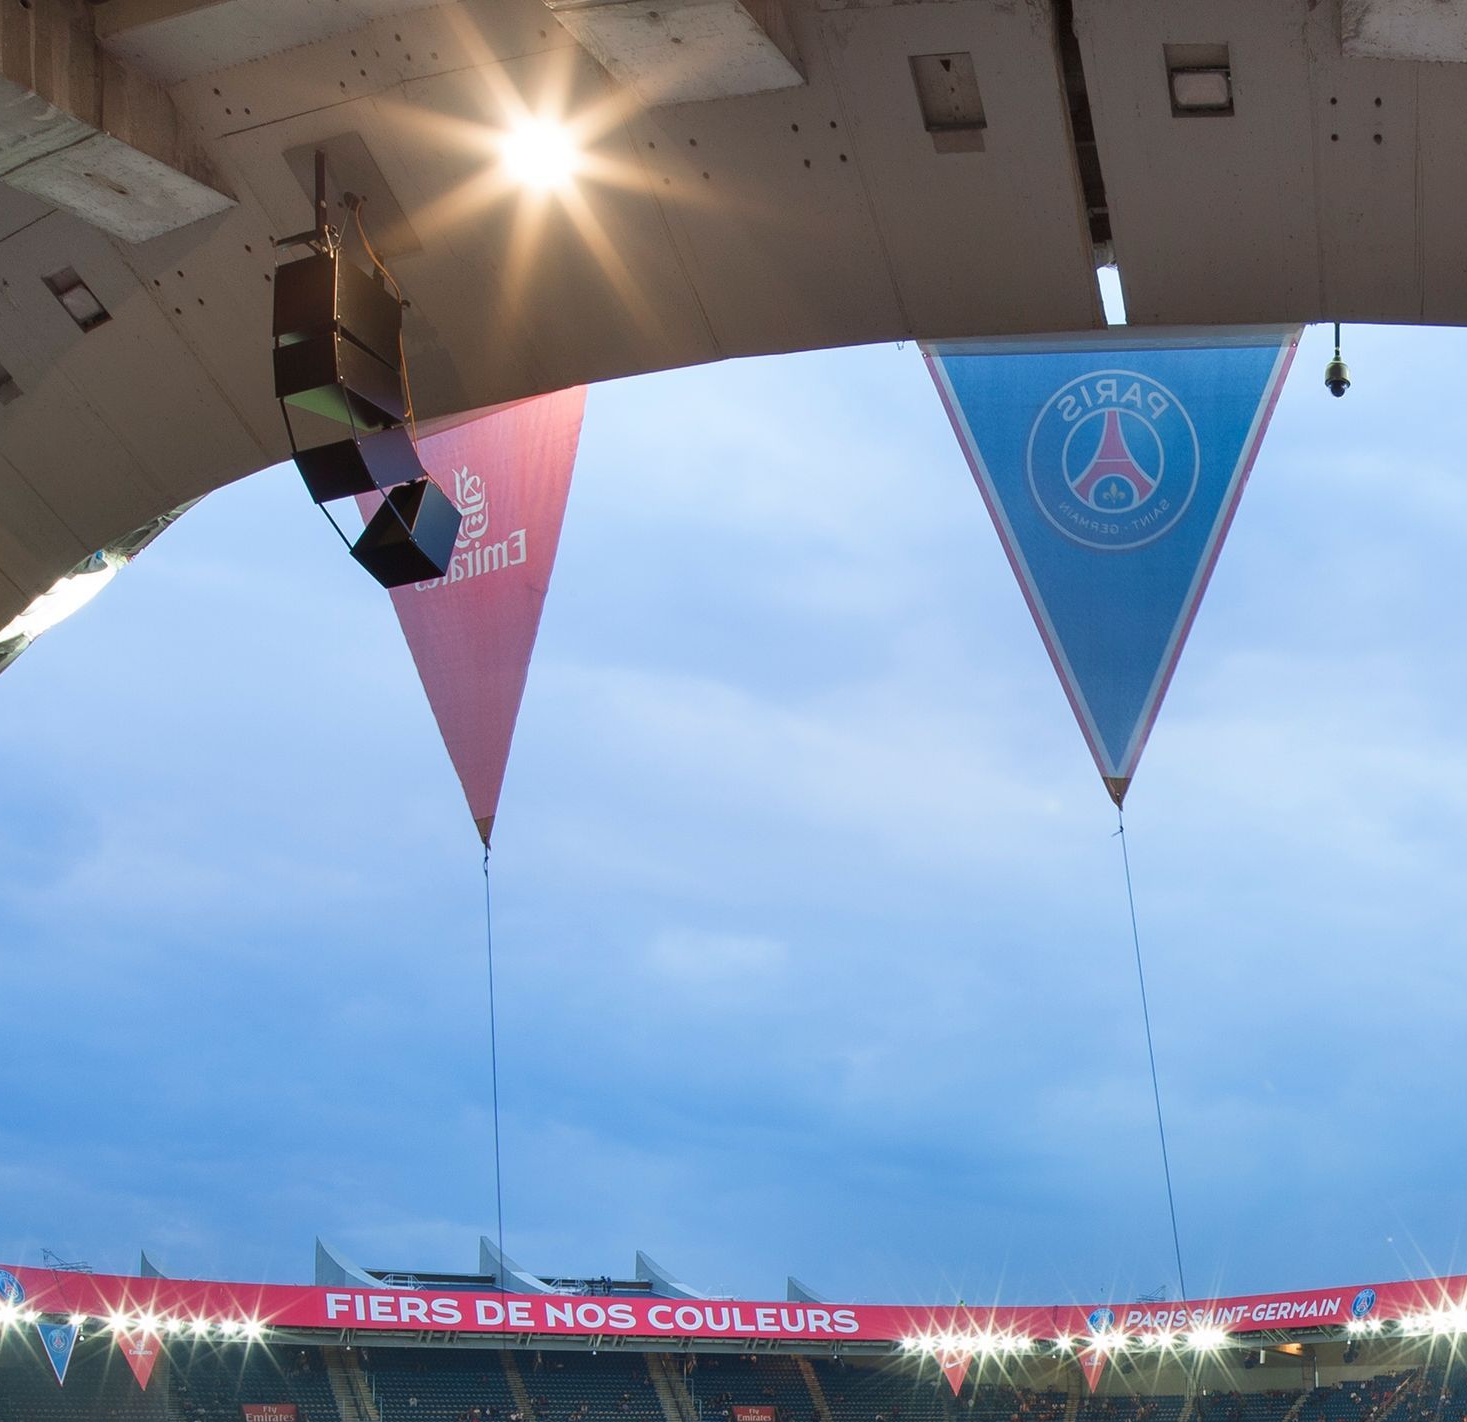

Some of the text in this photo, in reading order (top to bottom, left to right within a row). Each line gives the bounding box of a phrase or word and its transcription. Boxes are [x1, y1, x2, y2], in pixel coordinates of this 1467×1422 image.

[325, 1293, 860, 1334] FIERS DE NOS COULEURS
[1125, 1298, 1341, 1329] PARIS SAINT-GERMAIN
[263, 1405, 277, 1413] Fly
[246, 1413, 294, 1422] Emirates
[737, 1414, 772, 1422] Emirates
